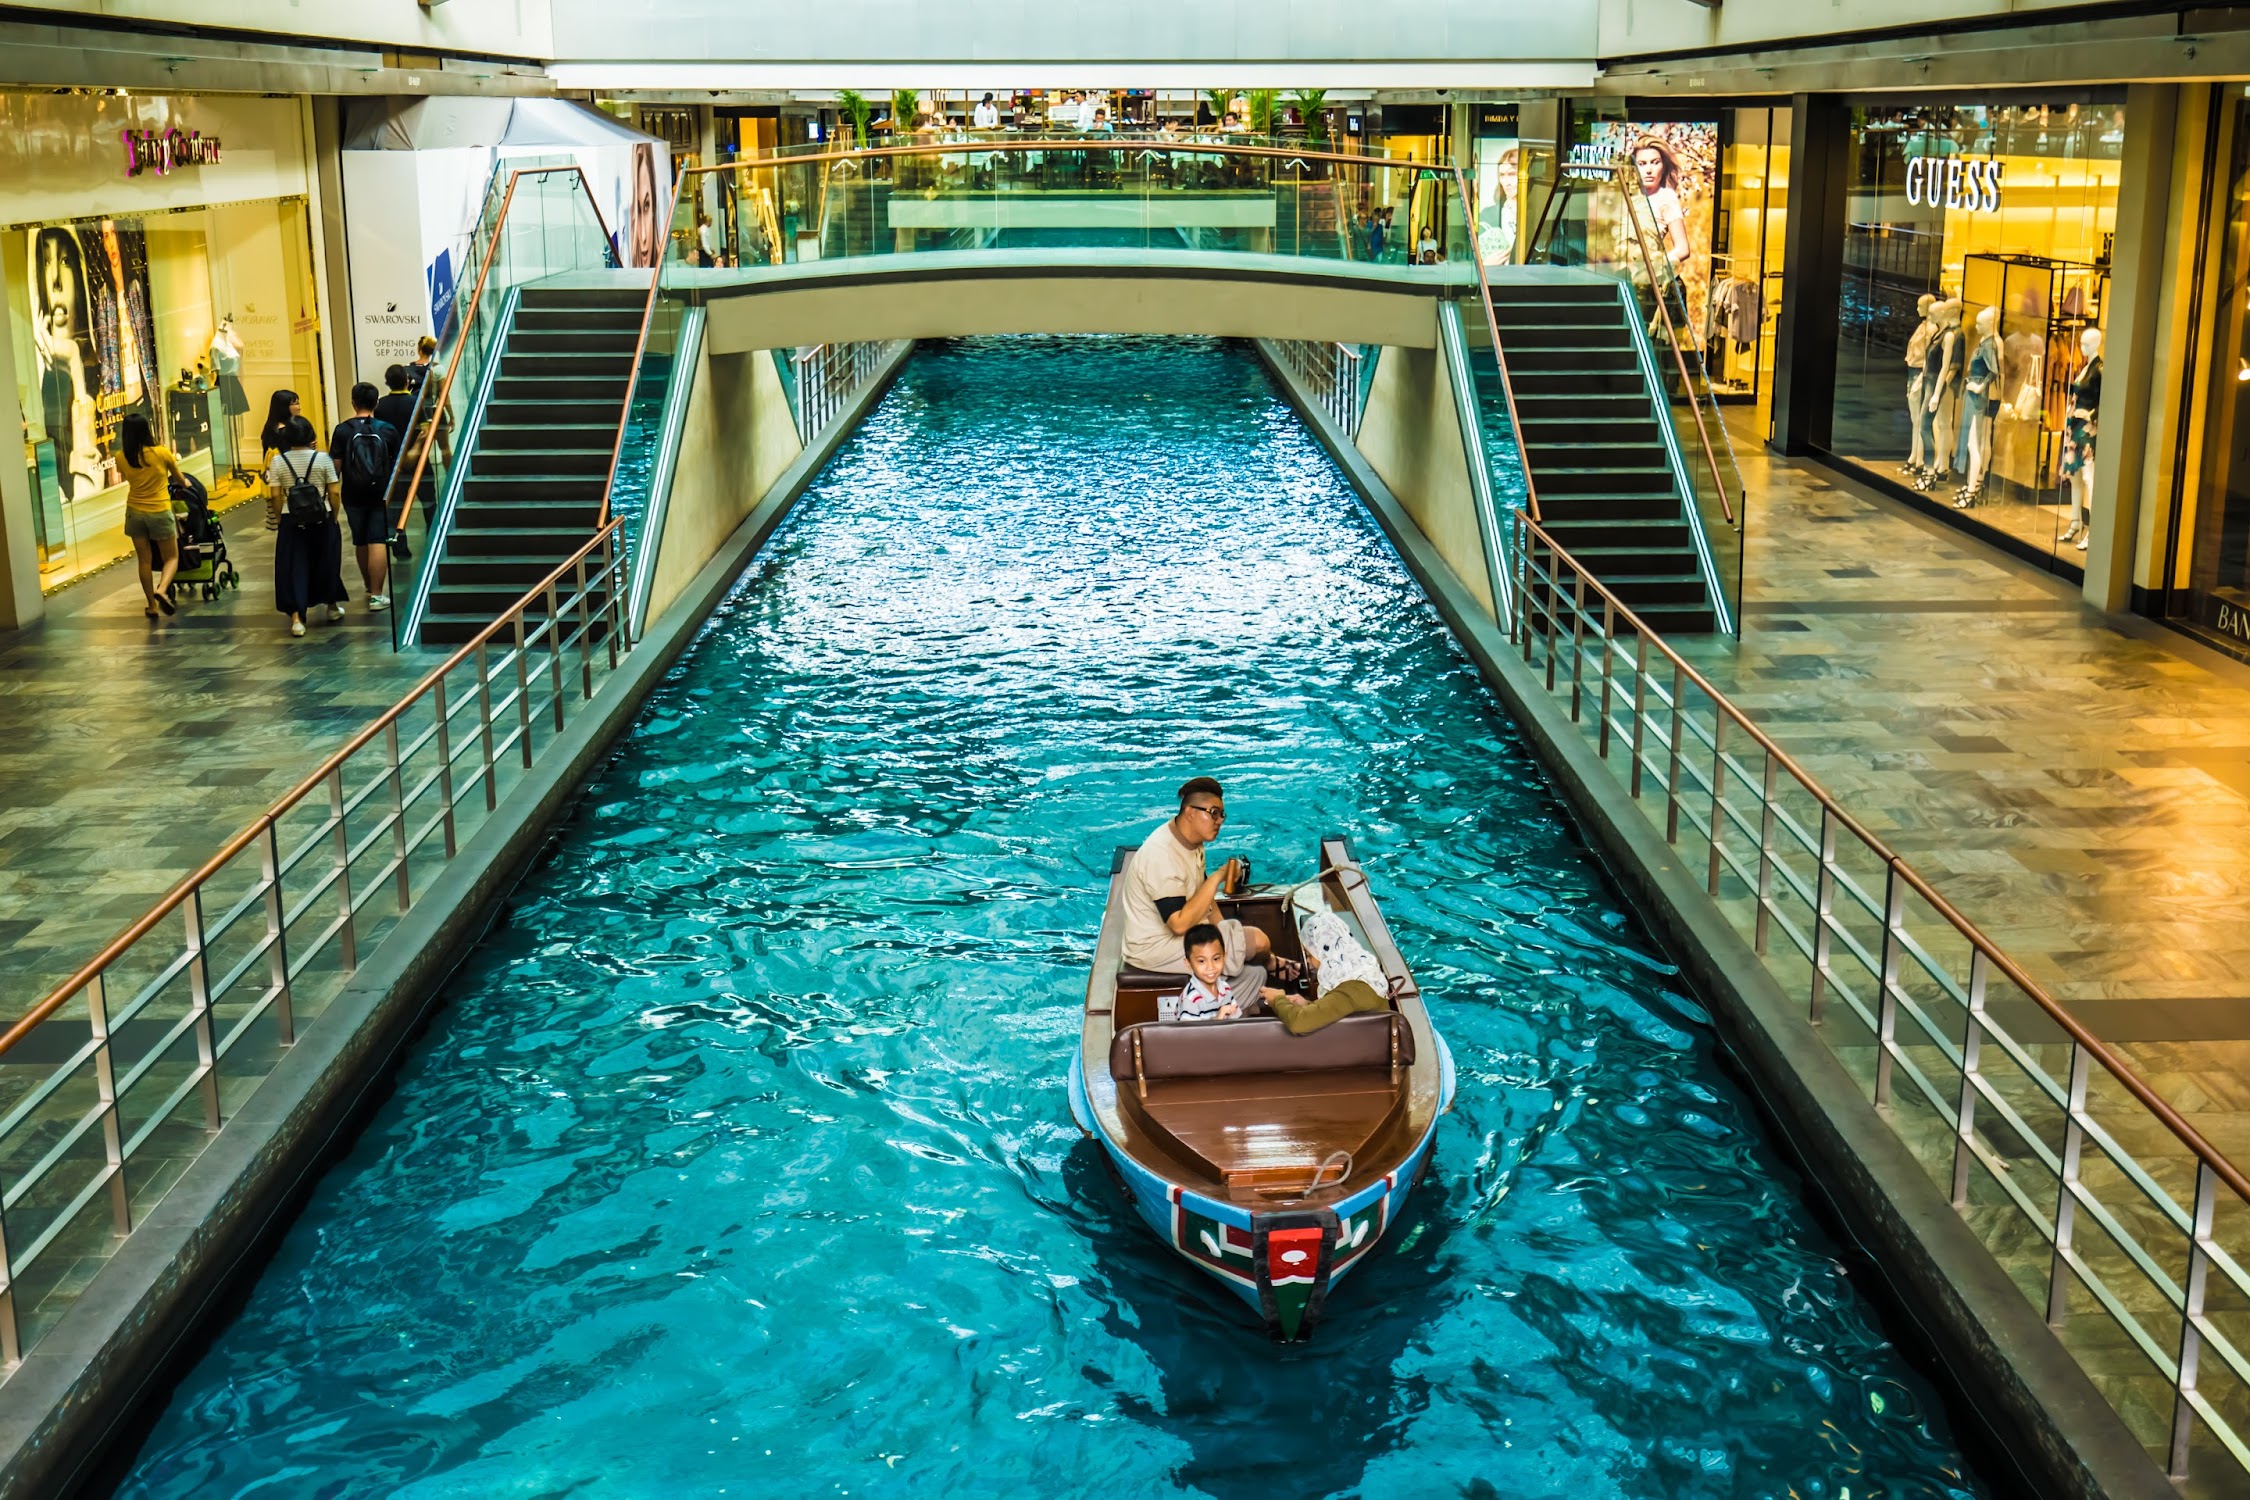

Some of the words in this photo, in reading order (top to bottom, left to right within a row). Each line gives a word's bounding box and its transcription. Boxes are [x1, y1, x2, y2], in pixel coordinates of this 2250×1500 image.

[1906, 156, 1999, 213] GUESS
[365, 315, 420, 324] SWAROVSKI
[374, 339, 415, 348] OPENING
[394, 349, 415, 357] 2016
